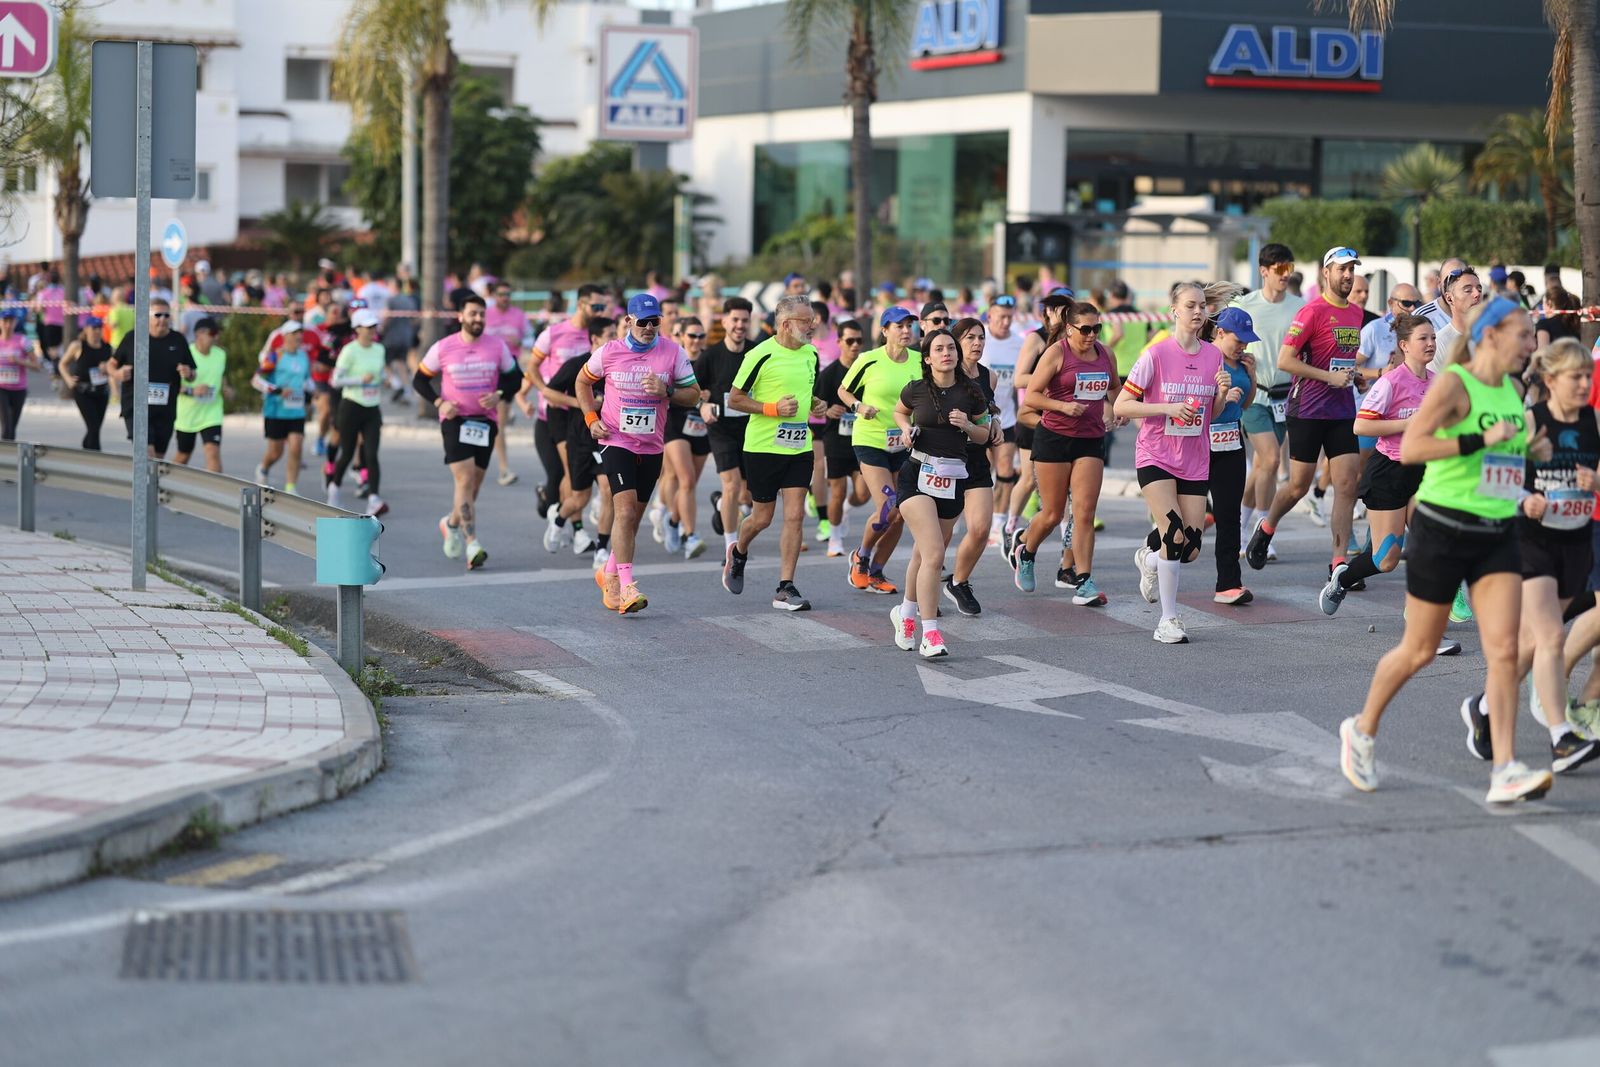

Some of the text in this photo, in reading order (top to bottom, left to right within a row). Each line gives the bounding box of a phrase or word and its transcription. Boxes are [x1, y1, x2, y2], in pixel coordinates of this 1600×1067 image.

[910, 0, 1003, 57] ALDI
[1209, 24, 1384, 80] ALDI
[611, 104, 681, 127] ALDI
[1079, 380, 1107, 391] 1469
[1183, 374, 1203, 384] XXXVI
[1161, 382, 1186, 394] MEDIA
[626, 415, 649, 426] 571
[777, 429, 807, 440] 2122
[1212, 430, 1240, 443] 2229
[926, 474, 951, 488] 780
[1485, 466, 1523, 486] 1176
[1551, 501, 1593, 517] 1286
